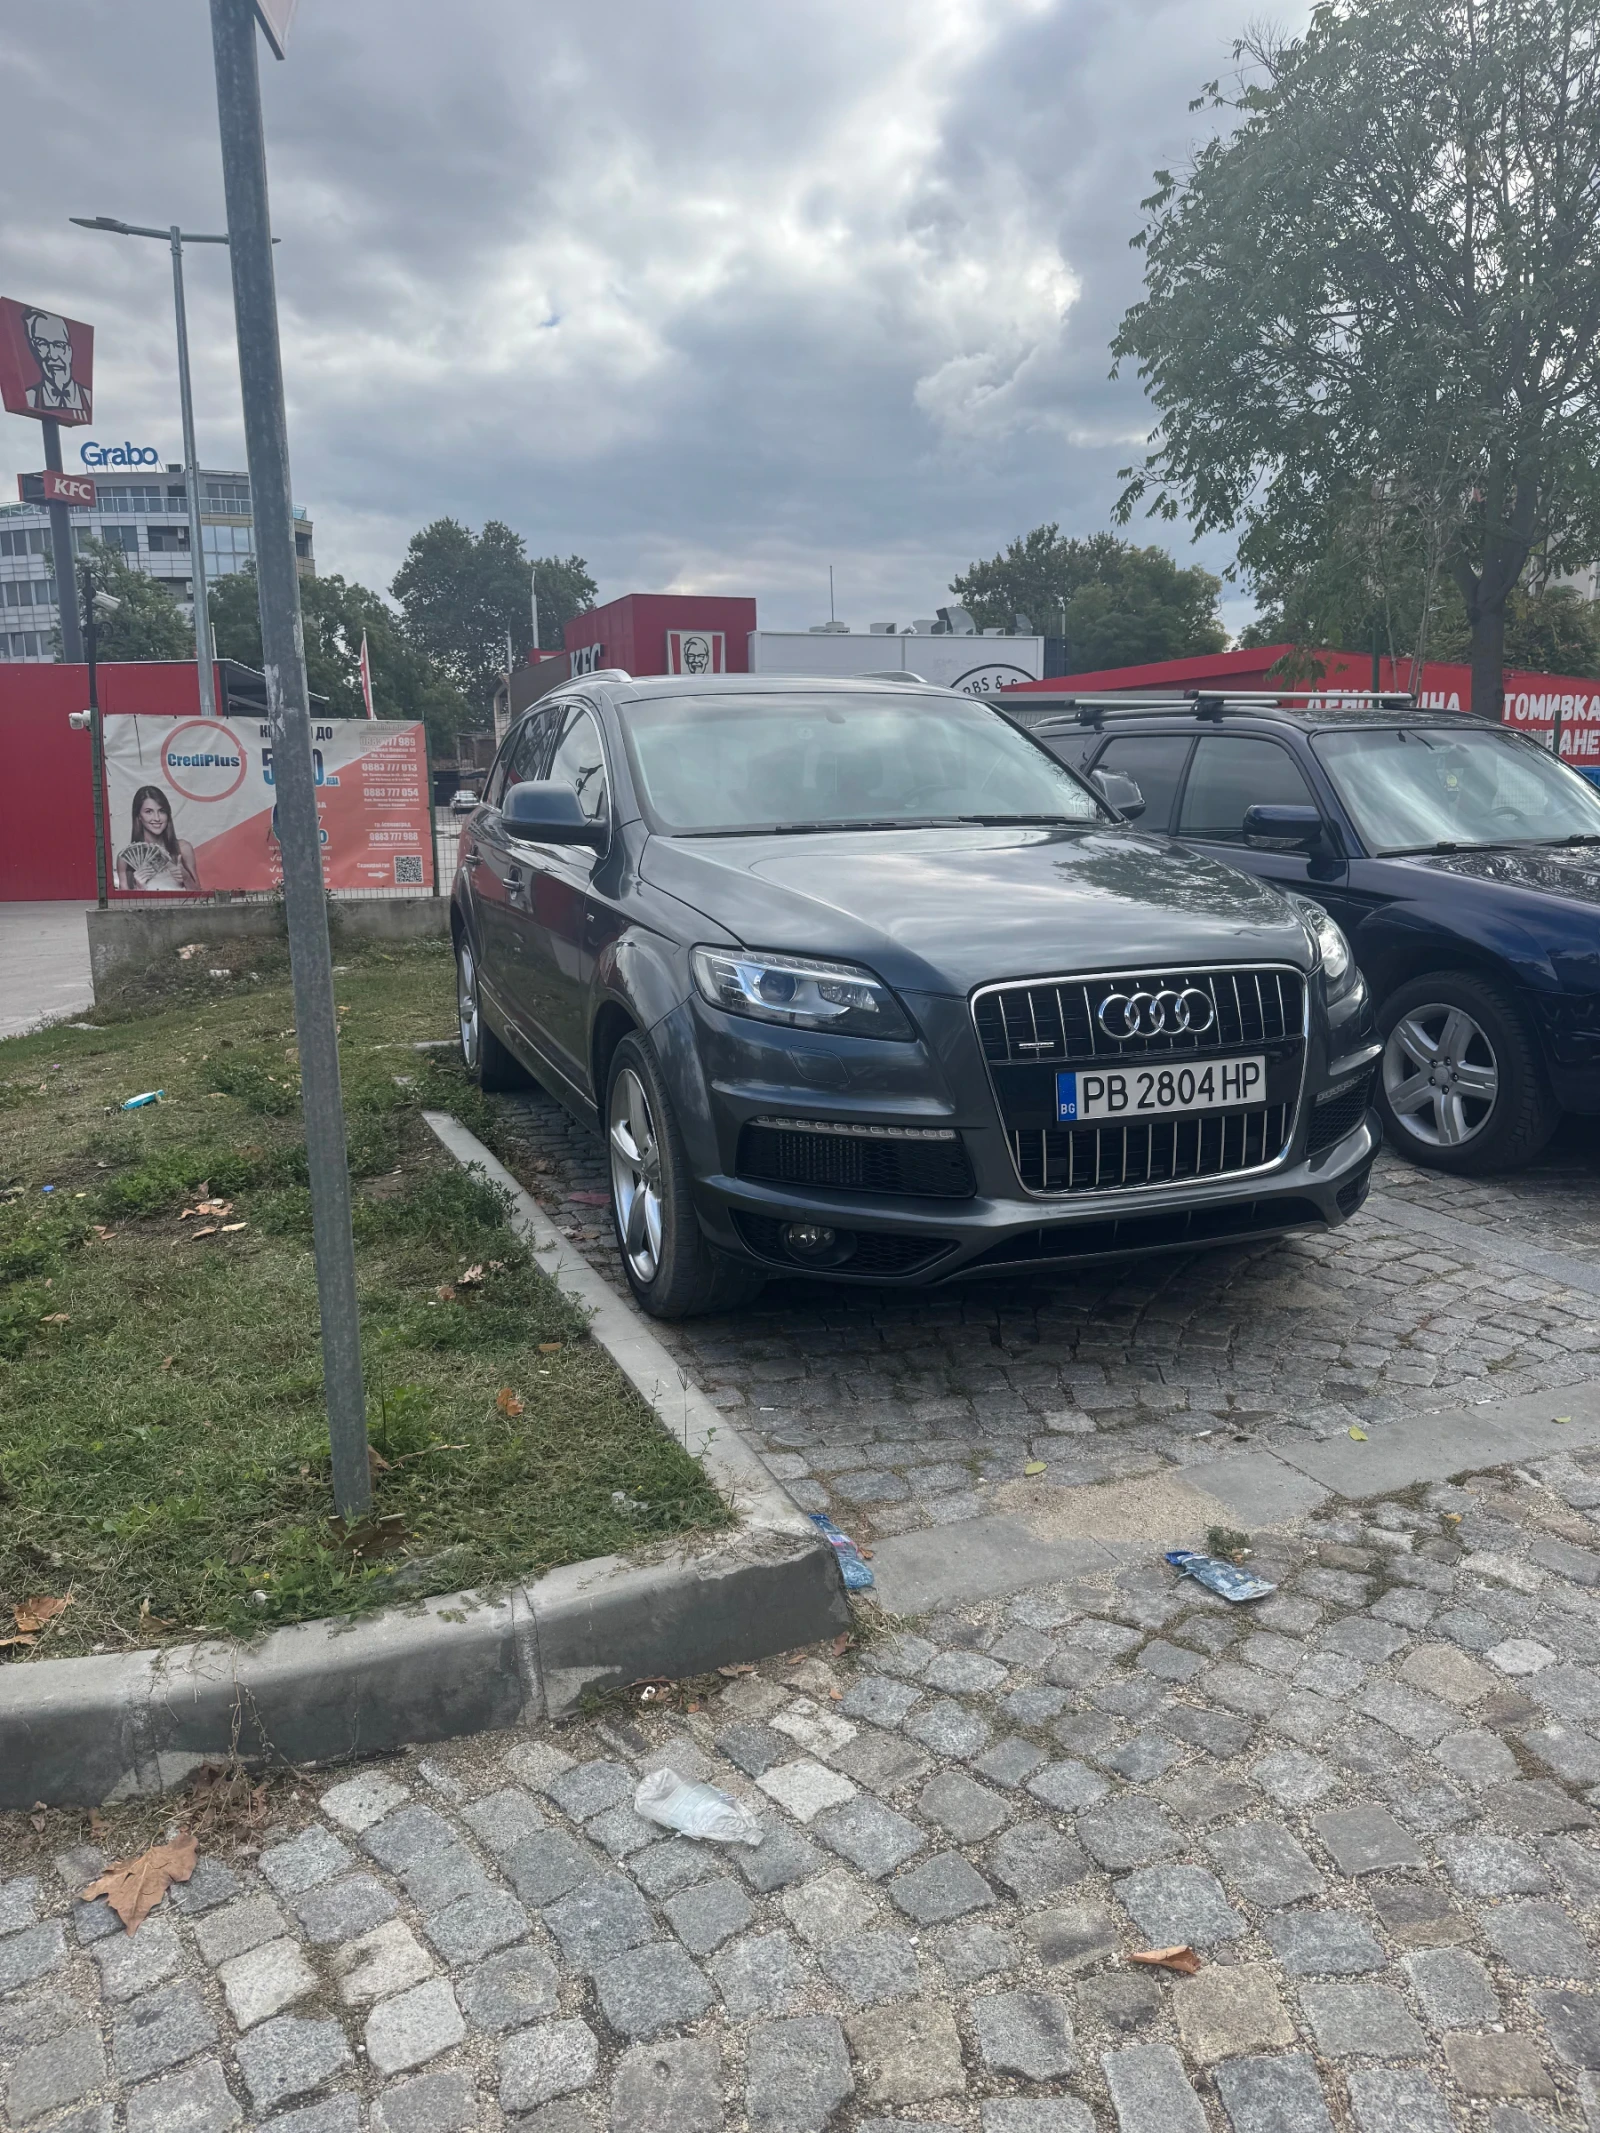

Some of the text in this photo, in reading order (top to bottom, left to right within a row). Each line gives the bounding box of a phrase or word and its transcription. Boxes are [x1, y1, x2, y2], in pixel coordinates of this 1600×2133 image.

[80, 441, 159, 466] Grabo
[53, 477, 92, 500] KFC
[1503, 693, 1600, 721] ТОМИВКА
[316, 726, 334, 741] ДО
[167, 753, 240, 767] CrediPlus
[362, 763, 385, 771] 0883
[363, 788, 419, 797] 0883 777 054
[369, 832, 389, 841] 0883
[390, 832, 402, 841] 777
[1083, 1062, 1260, 1114] PB 2804 HP
[1060, 1103, 1076, 1115] BG
